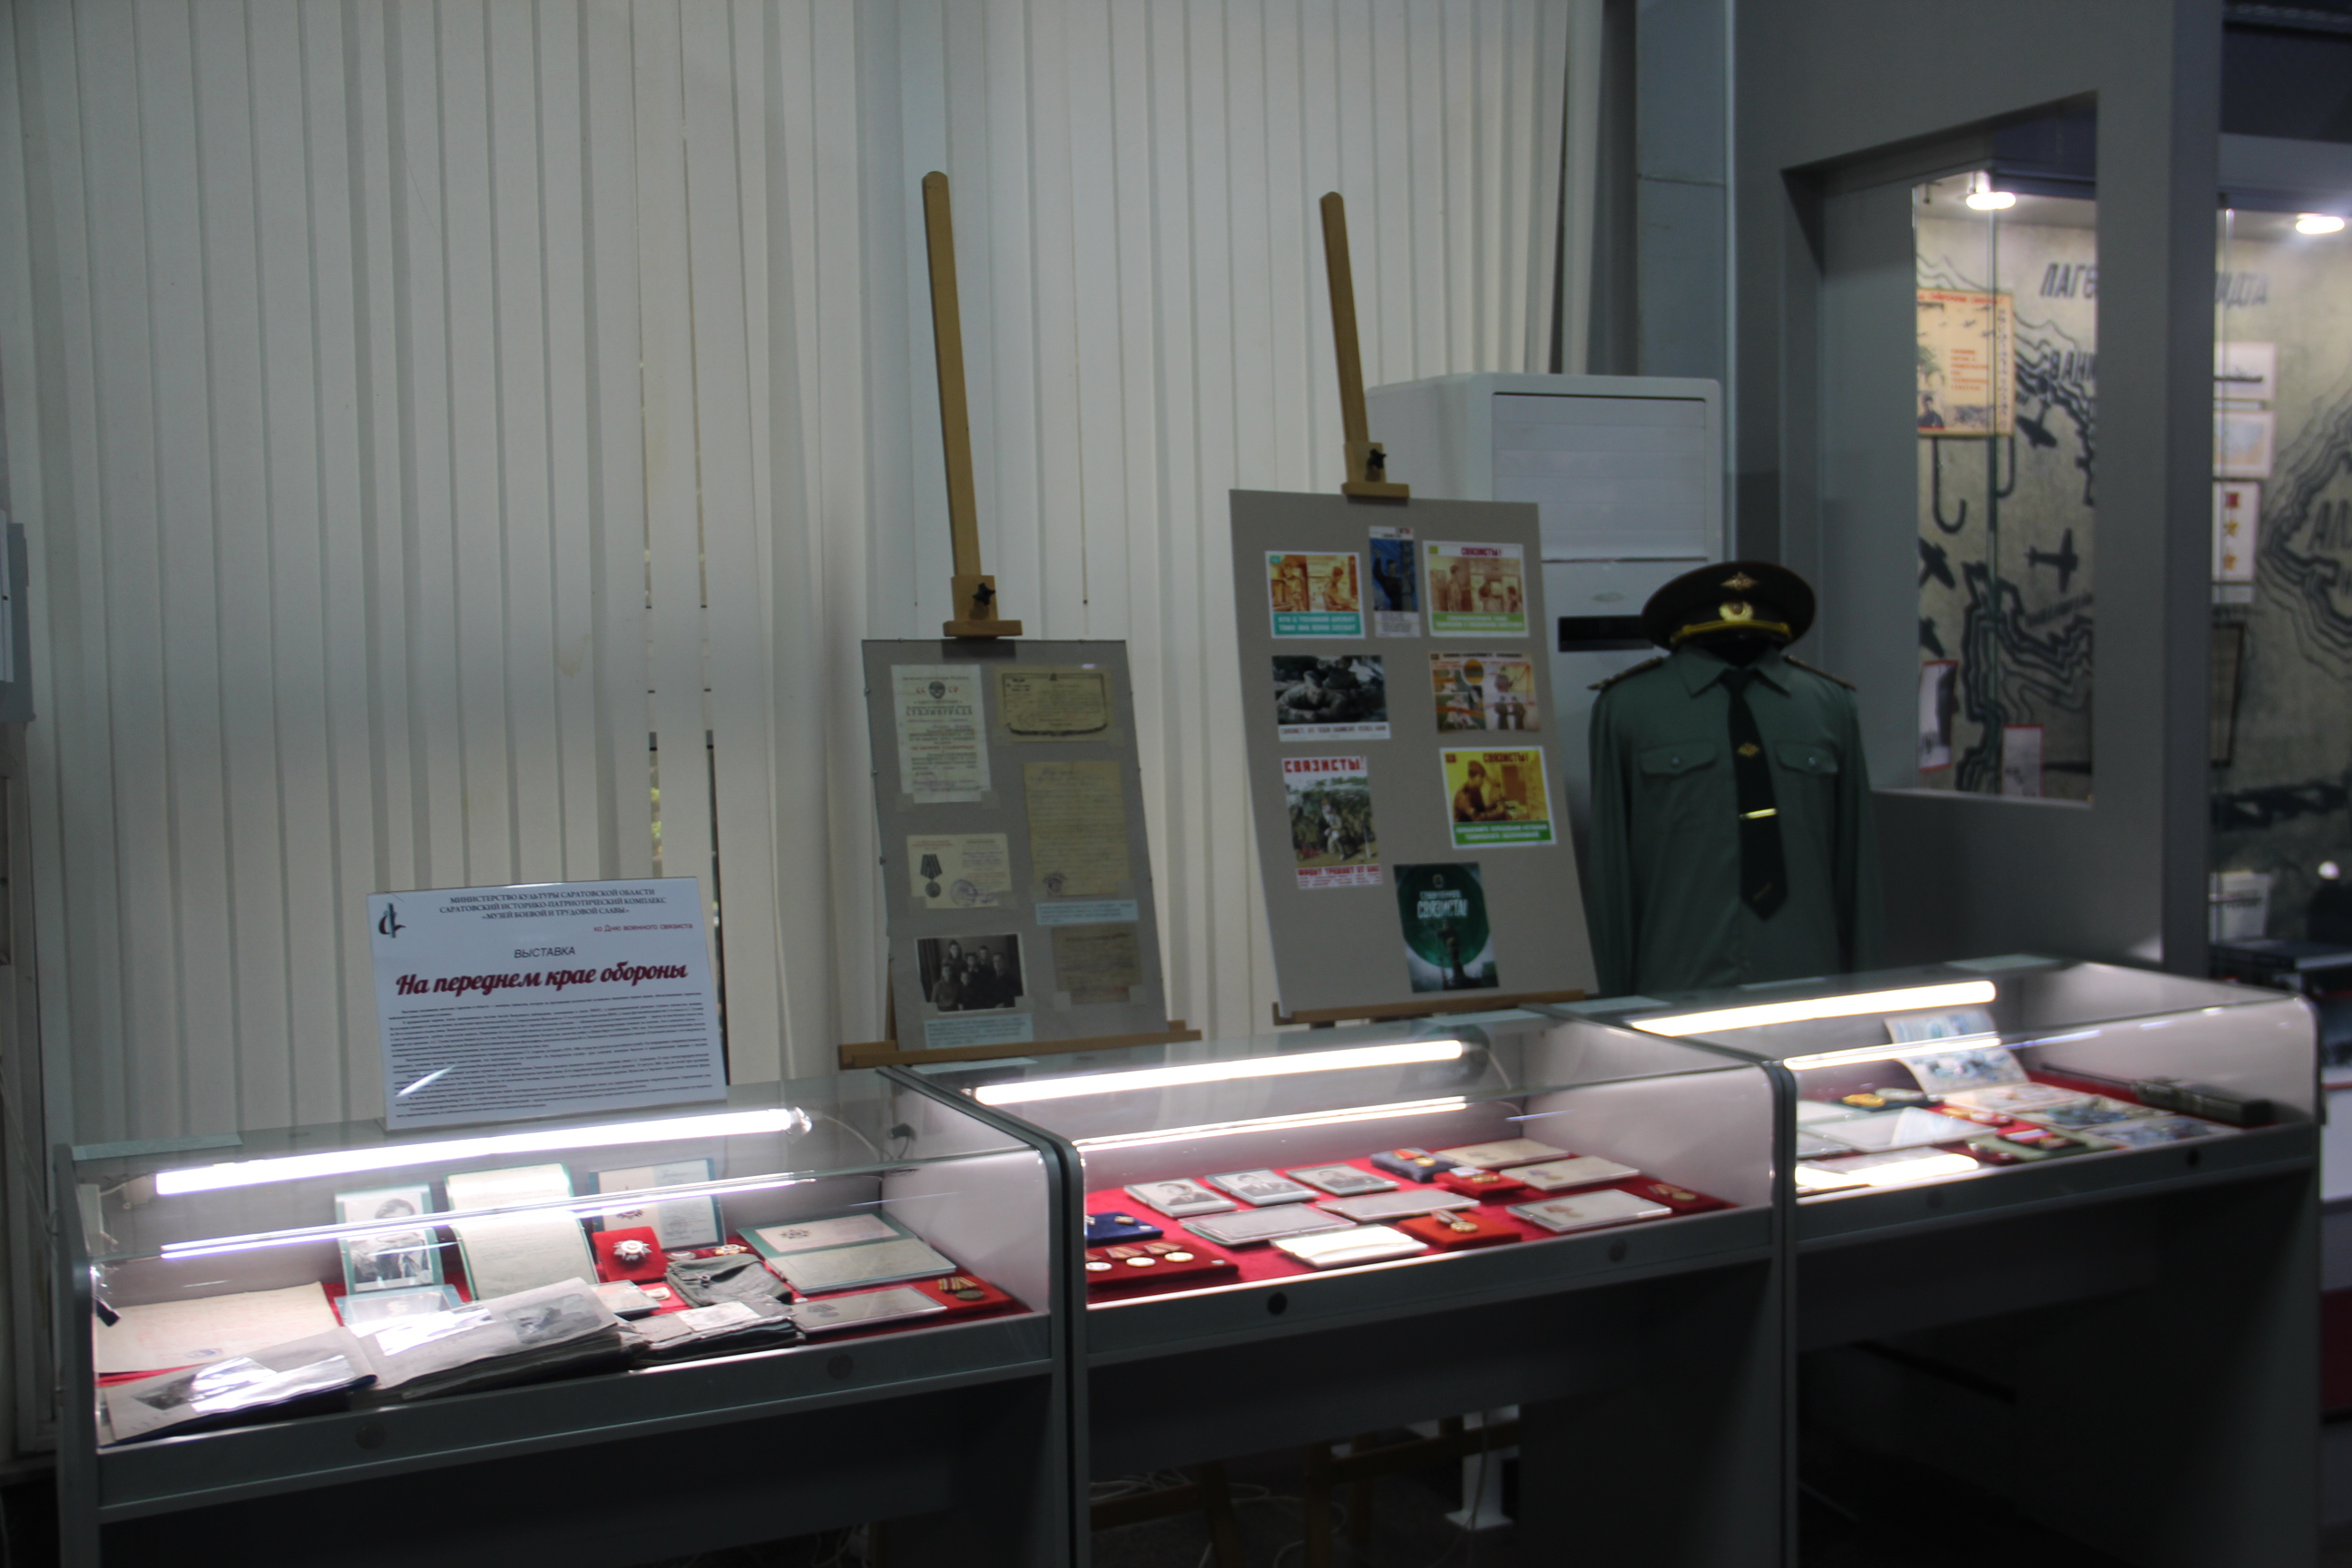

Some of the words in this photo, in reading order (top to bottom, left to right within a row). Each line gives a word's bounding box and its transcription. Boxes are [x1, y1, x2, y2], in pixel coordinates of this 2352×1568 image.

[1284, 757, 1366, 773] СВЯЗИСТЫ!
[450, 894, 517, 904] МИНИСТЕРСТВО
[518, 892, 560, 900] КУЛЬТУРЫ
[561, 888, 618, 898] САРАТОВСКОЙ
[439, 903, 500, 913] САРАТОВСКИЙ
[501, 897, 623, 910] ИСТОРИКО-ПАТРИОТИЧЕСКИЙ
[624, 897, 667, 906] КОМПЛЕКС
[514, 910, 547, 918] БОЕВОЙ
[555, 906, 598, 916] ТРУДОВОЙ
[514, 946, 576, 958] ВЫСТАВКА
[396, 974, 430, 995] На
[432, 972, 543, 997] переднем
[544, 968, 596, 991] крае
[600, 960, 689, 986] обороны
